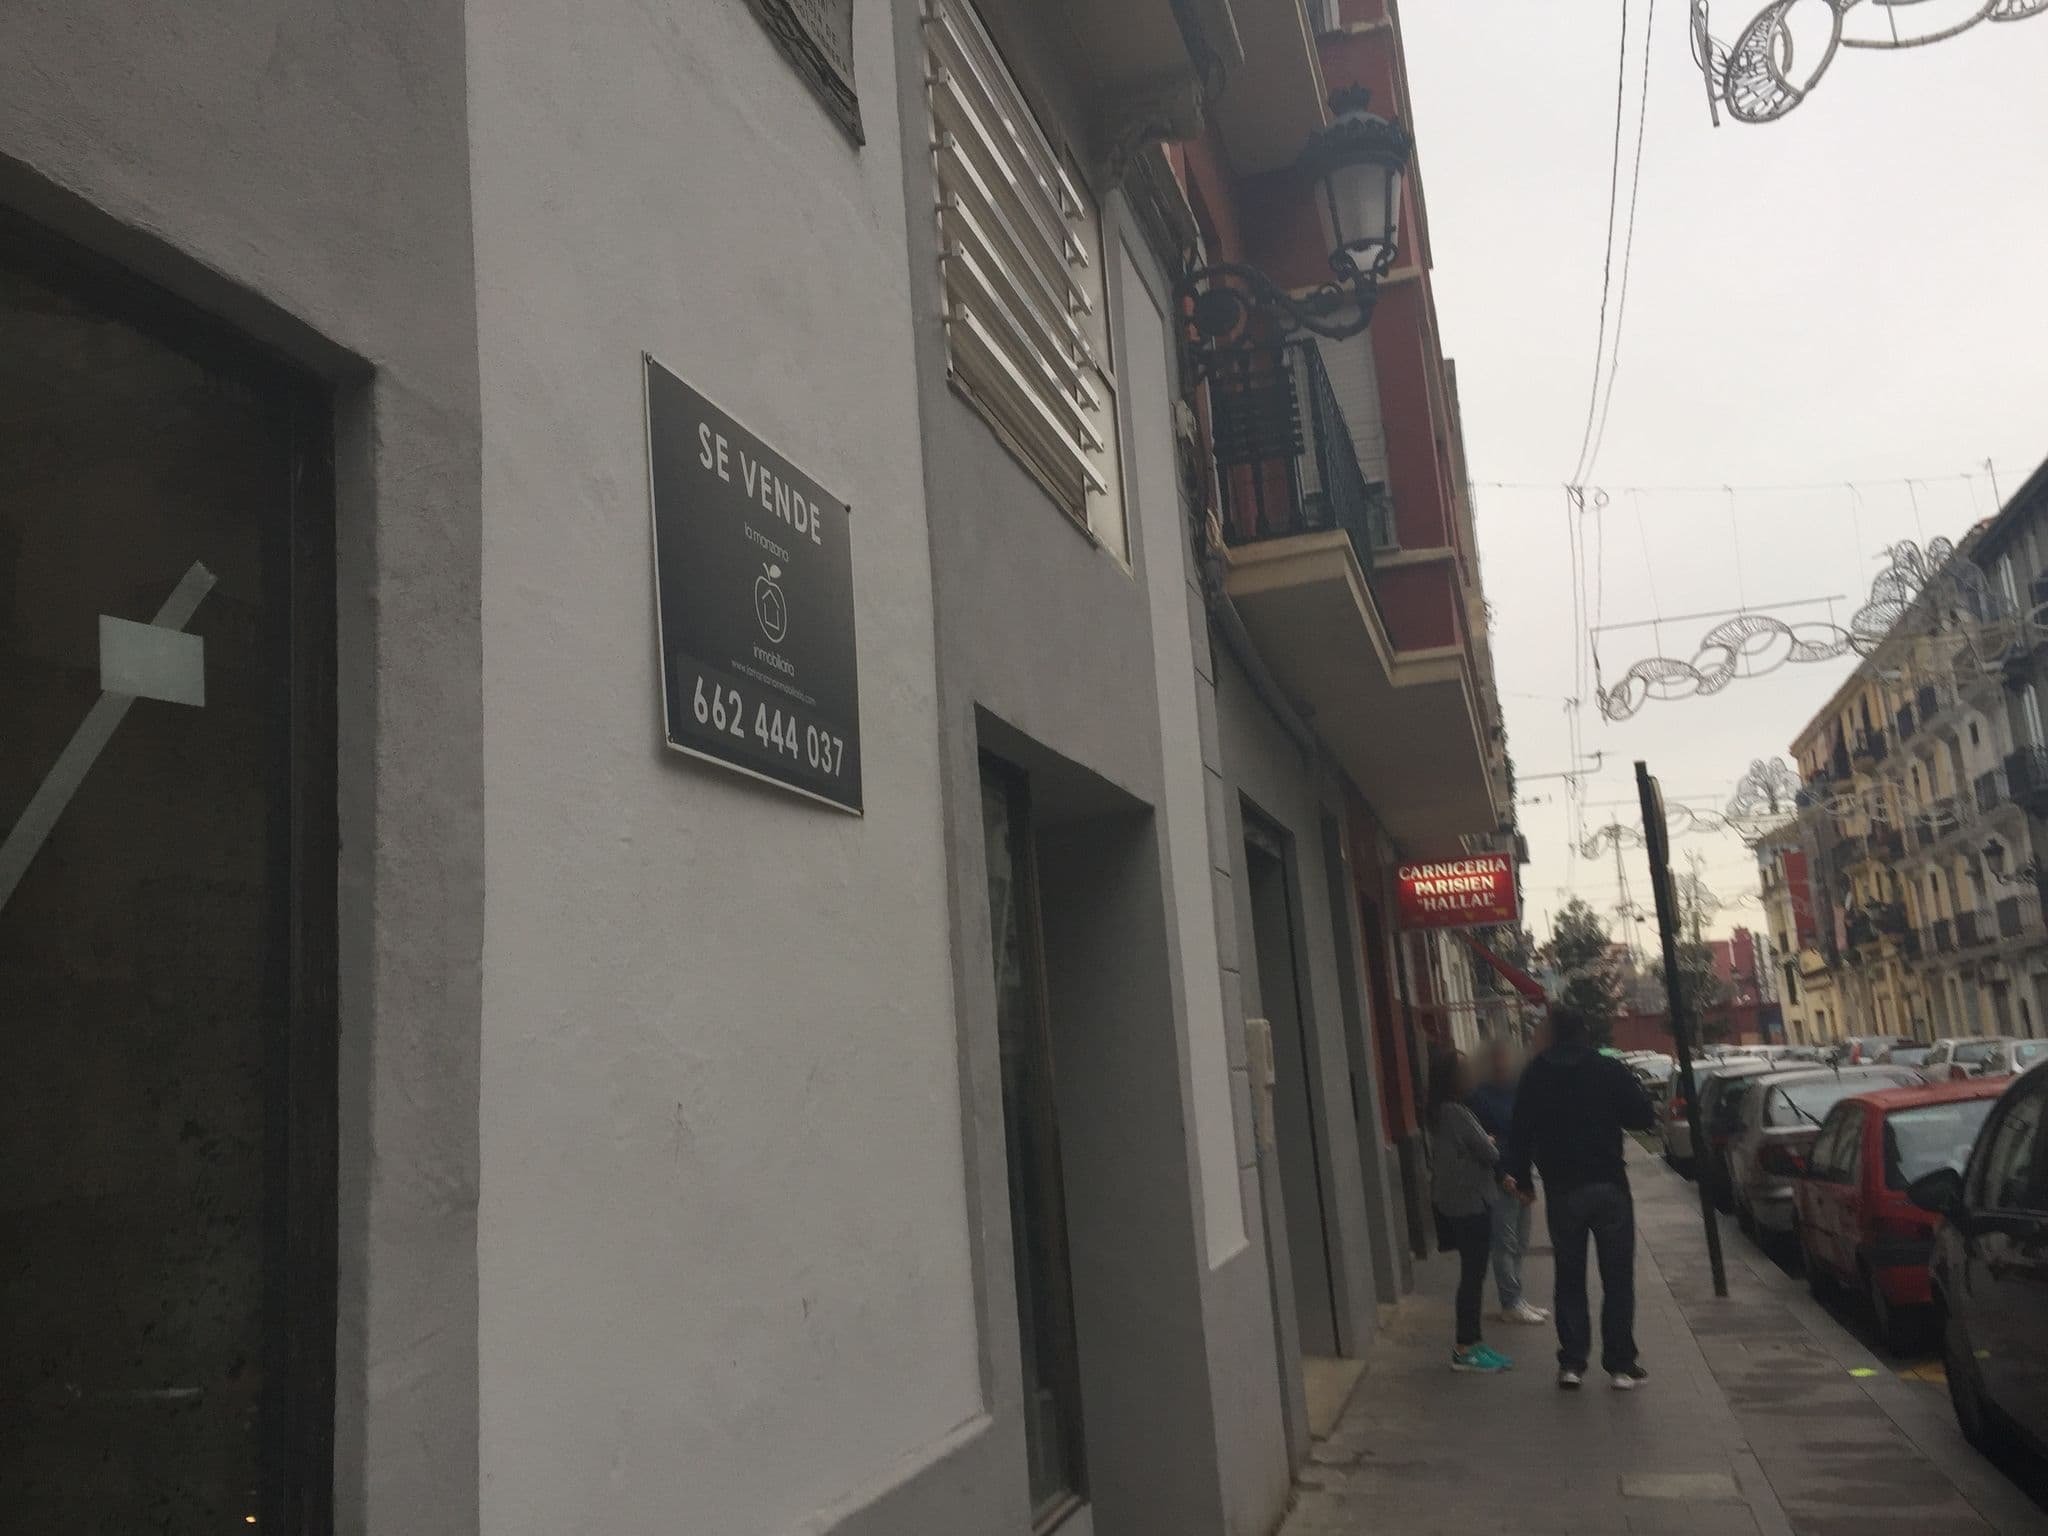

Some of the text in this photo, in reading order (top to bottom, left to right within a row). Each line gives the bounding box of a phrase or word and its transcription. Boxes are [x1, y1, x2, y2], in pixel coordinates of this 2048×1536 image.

[699, 422, 821, 545] SE VENDE
[694, 675, 745, 738] 662
[755, 702, 799, 760] 444
[807, 724, 844, 777] 037
[1399, 857, 1507, 880] CARNICERIA
[1414, 875, 1495, 896] PARISIEN
